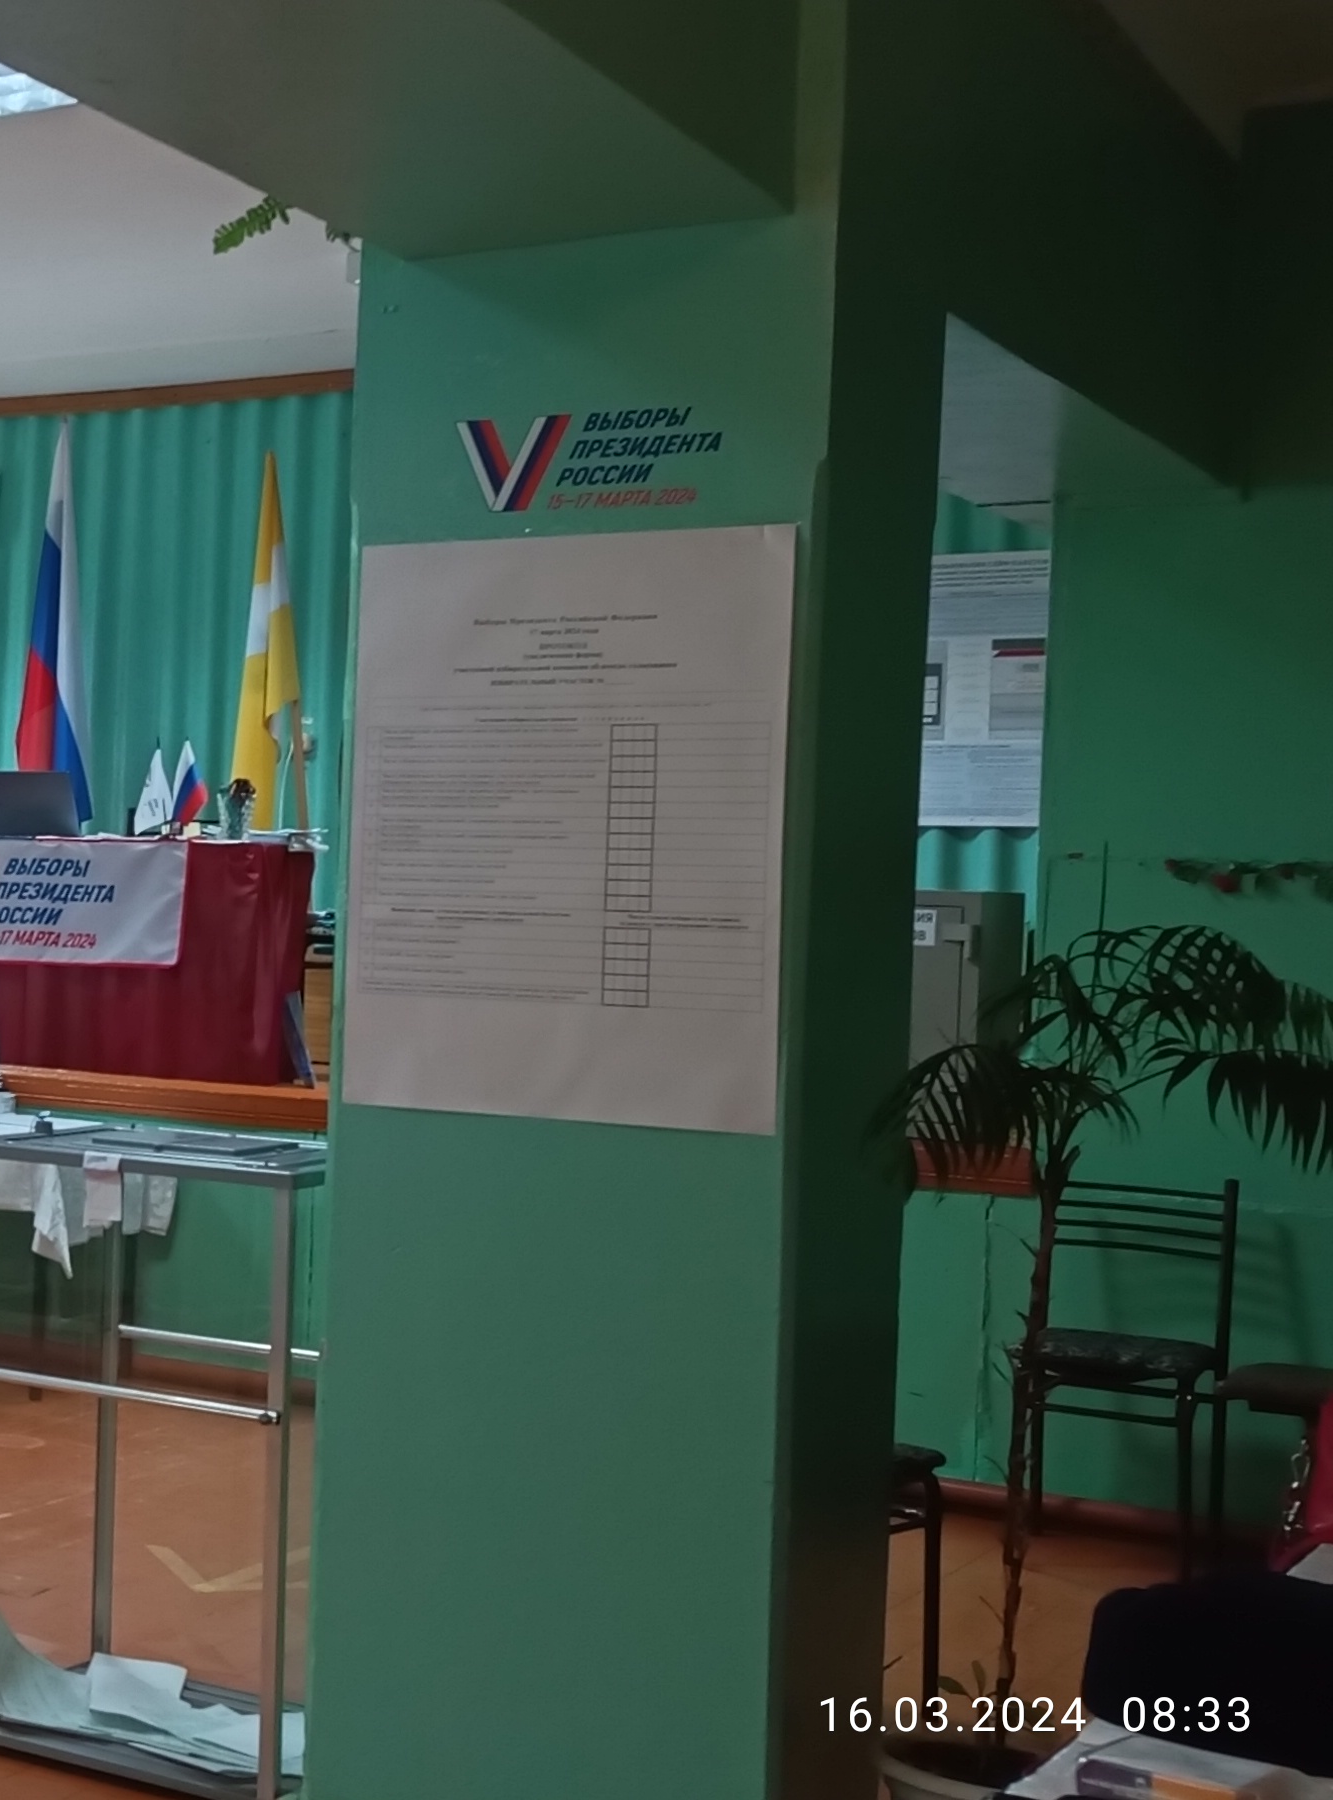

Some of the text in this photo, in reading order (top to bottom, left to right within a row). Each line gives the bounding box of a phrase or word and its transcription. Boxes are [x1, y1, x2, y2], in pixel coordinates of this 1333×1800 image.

[583, 406, 692, 433] ВЫБОРЫ
[569, 432, 723, 460] ПРЕЗИДЕНТА
[556, 463, 654, 488] РОССИИ
[593, 489, 653, 508] МАРТА
[654, 488, 698, 506] 2024
[4, 858, 91, 878] ВЫБОРЫ
[14, 930, 61, 948] МАРТА
[62, 932, 97, 949] 2024
